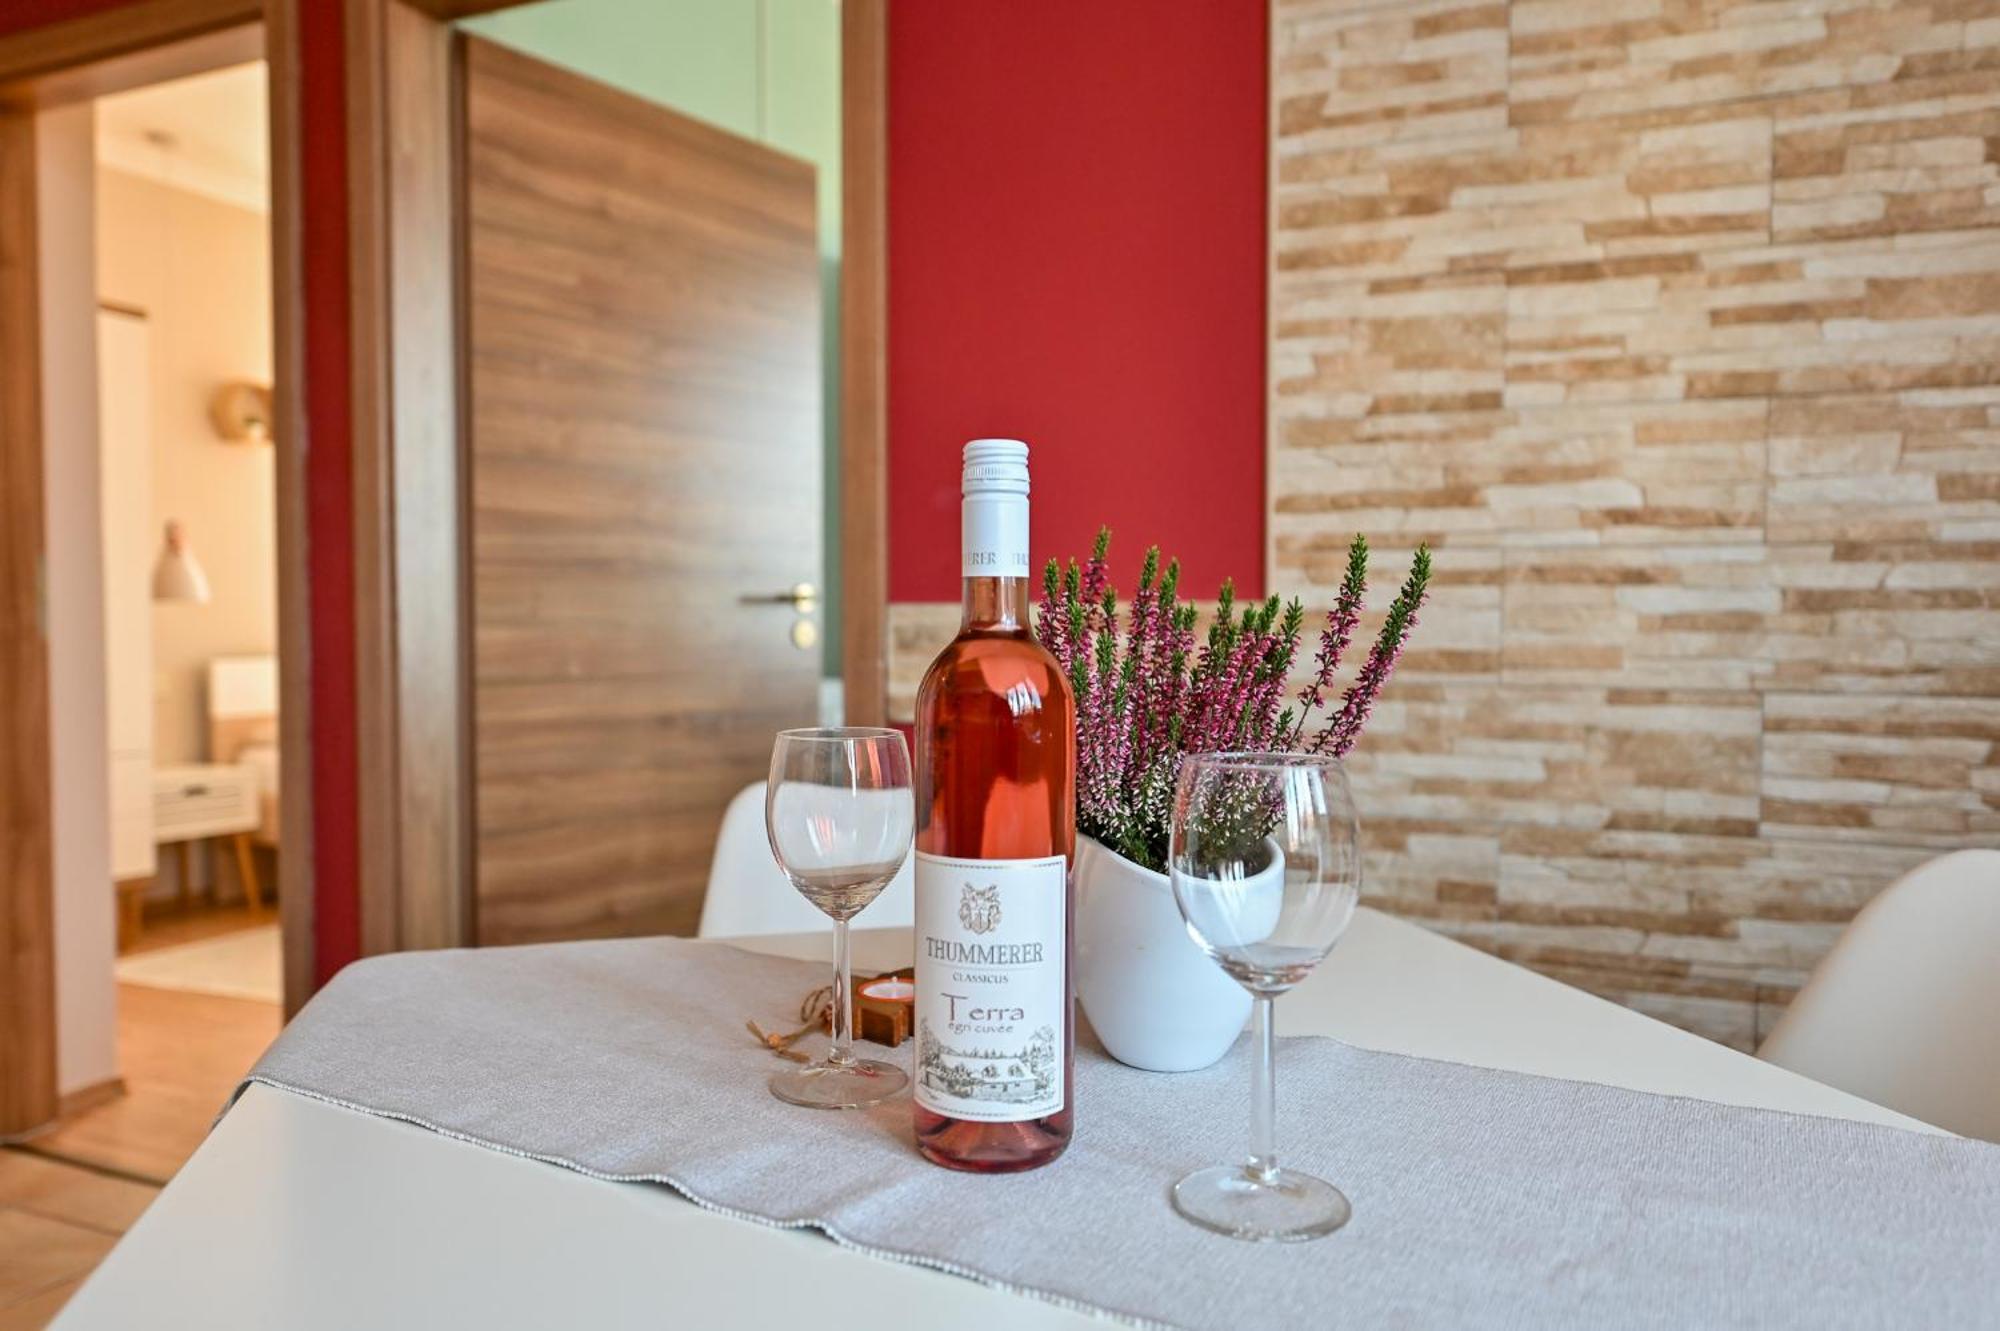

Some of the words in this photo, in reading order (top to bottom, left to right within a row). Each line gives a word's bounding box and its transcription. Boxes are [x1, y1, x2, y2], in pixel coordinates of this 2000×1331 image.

[926, 936, 1044, 964] THUMMERER
[952, 972, 1009, 984] CLASSICUS
[941, 992, 1025, 1021] Terra
